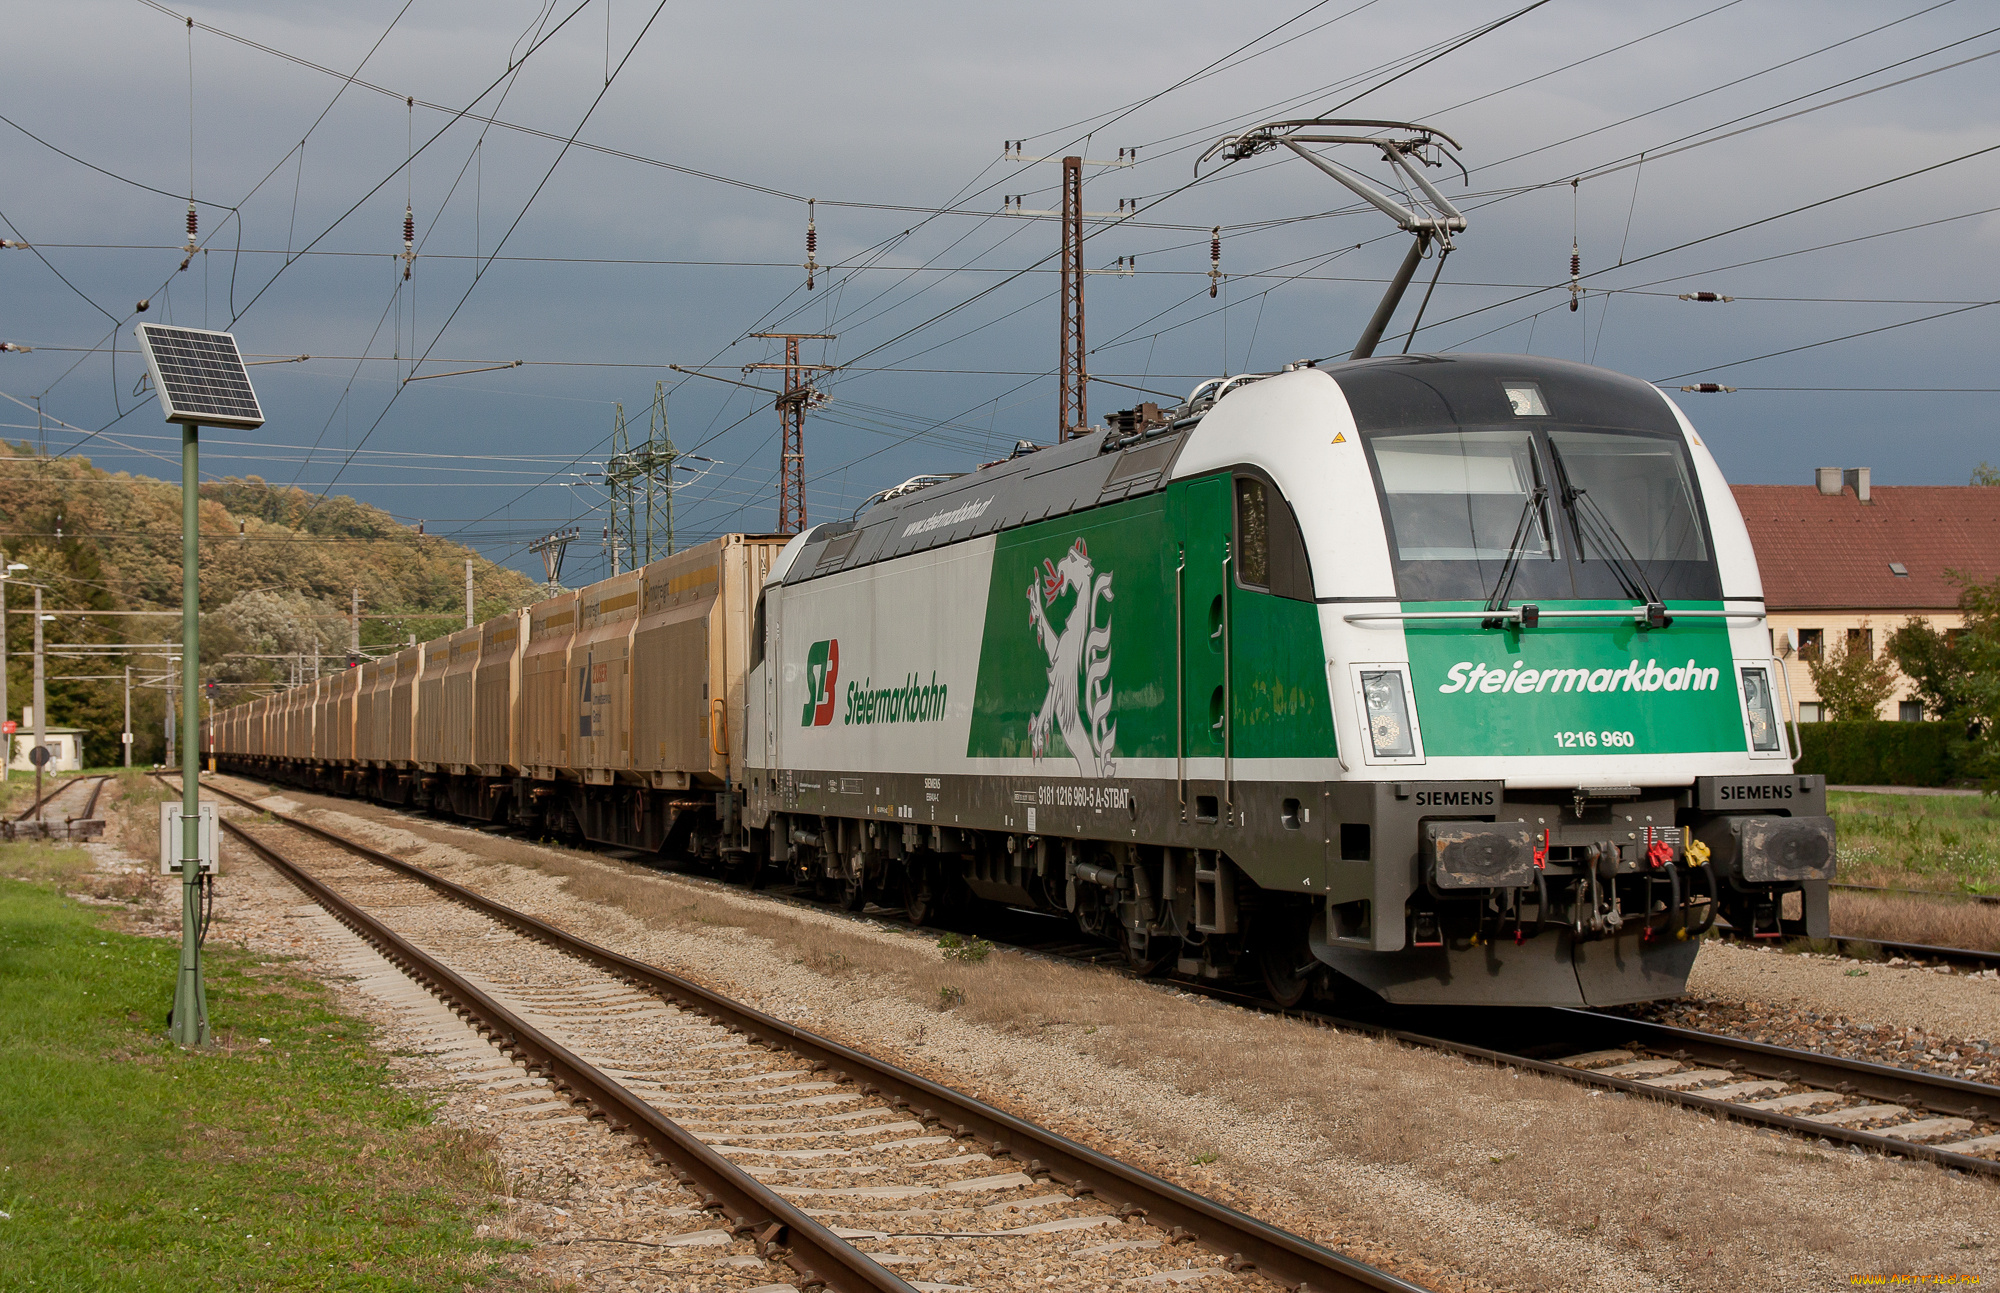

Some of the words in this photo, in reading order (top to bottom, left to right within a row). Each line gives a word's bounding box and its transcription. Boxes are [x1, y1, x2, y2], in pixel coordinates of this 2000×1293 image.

[1438, 658, 1720, 694] Steiermarkbahn
[844, 669, 948, 726] Steiermarkbahn
[1553, 731, 1597, 748] 1216
[1600, 730, 1635, 747] 960
[1038, 785, 1054, 806] 9181
[1056, 785, 1073, 806] 1216
[1073, 786, 1094, 807] 960-5
[1095, 787, 1129, 809] A-STBAT
[1415, 791, 1494, 806] SIEMENS
[1720, 785, 1793, 800] SIEMENS
